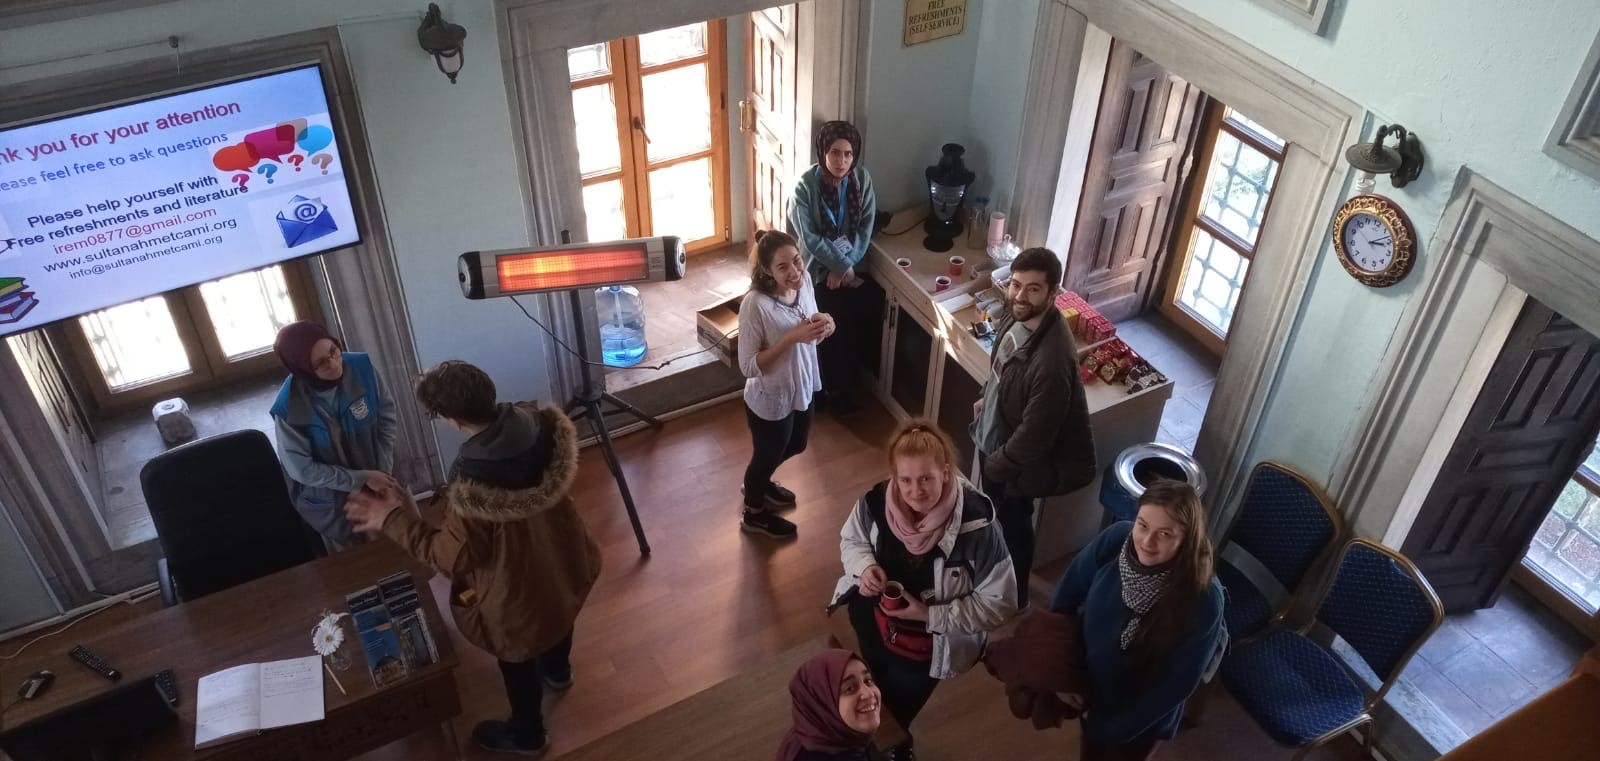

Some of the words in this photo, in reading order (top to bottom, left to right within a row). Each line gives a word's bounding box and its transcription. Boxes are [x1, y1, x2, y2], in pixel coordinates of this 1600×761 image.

[25, 140, 67, 161] you
[70, 133, 99, 148] for
[104, 122, 149, 144] your
[155, 102, 241, 130] attention
[0, 176, 37, 191] ease
[40, 165, 71, 182] feel
[73, 161, 106, 174] free
[108, 157, 125, 166] to
[129, 147, 154, 162] ask
[157, 133, 228, 157] questions
[8, 235, 45, 249] Free
[48, 209, 149, 240] refreshments
[153, 199, 181, 214] and
[184, 185, 249, 207] literature
[27, 208, 84, 228] Please
[86, 200, 121, 214] help
[124, 182, 184, 207] yourself
[187, 175, 218, 190] with
[43, 218, 237, 272] www.sultanahmetcami.org
[53, 208, 217, 254] irem0877@gmail.com
[69, 235, 223, 279] info@sultanahmetcami.org
